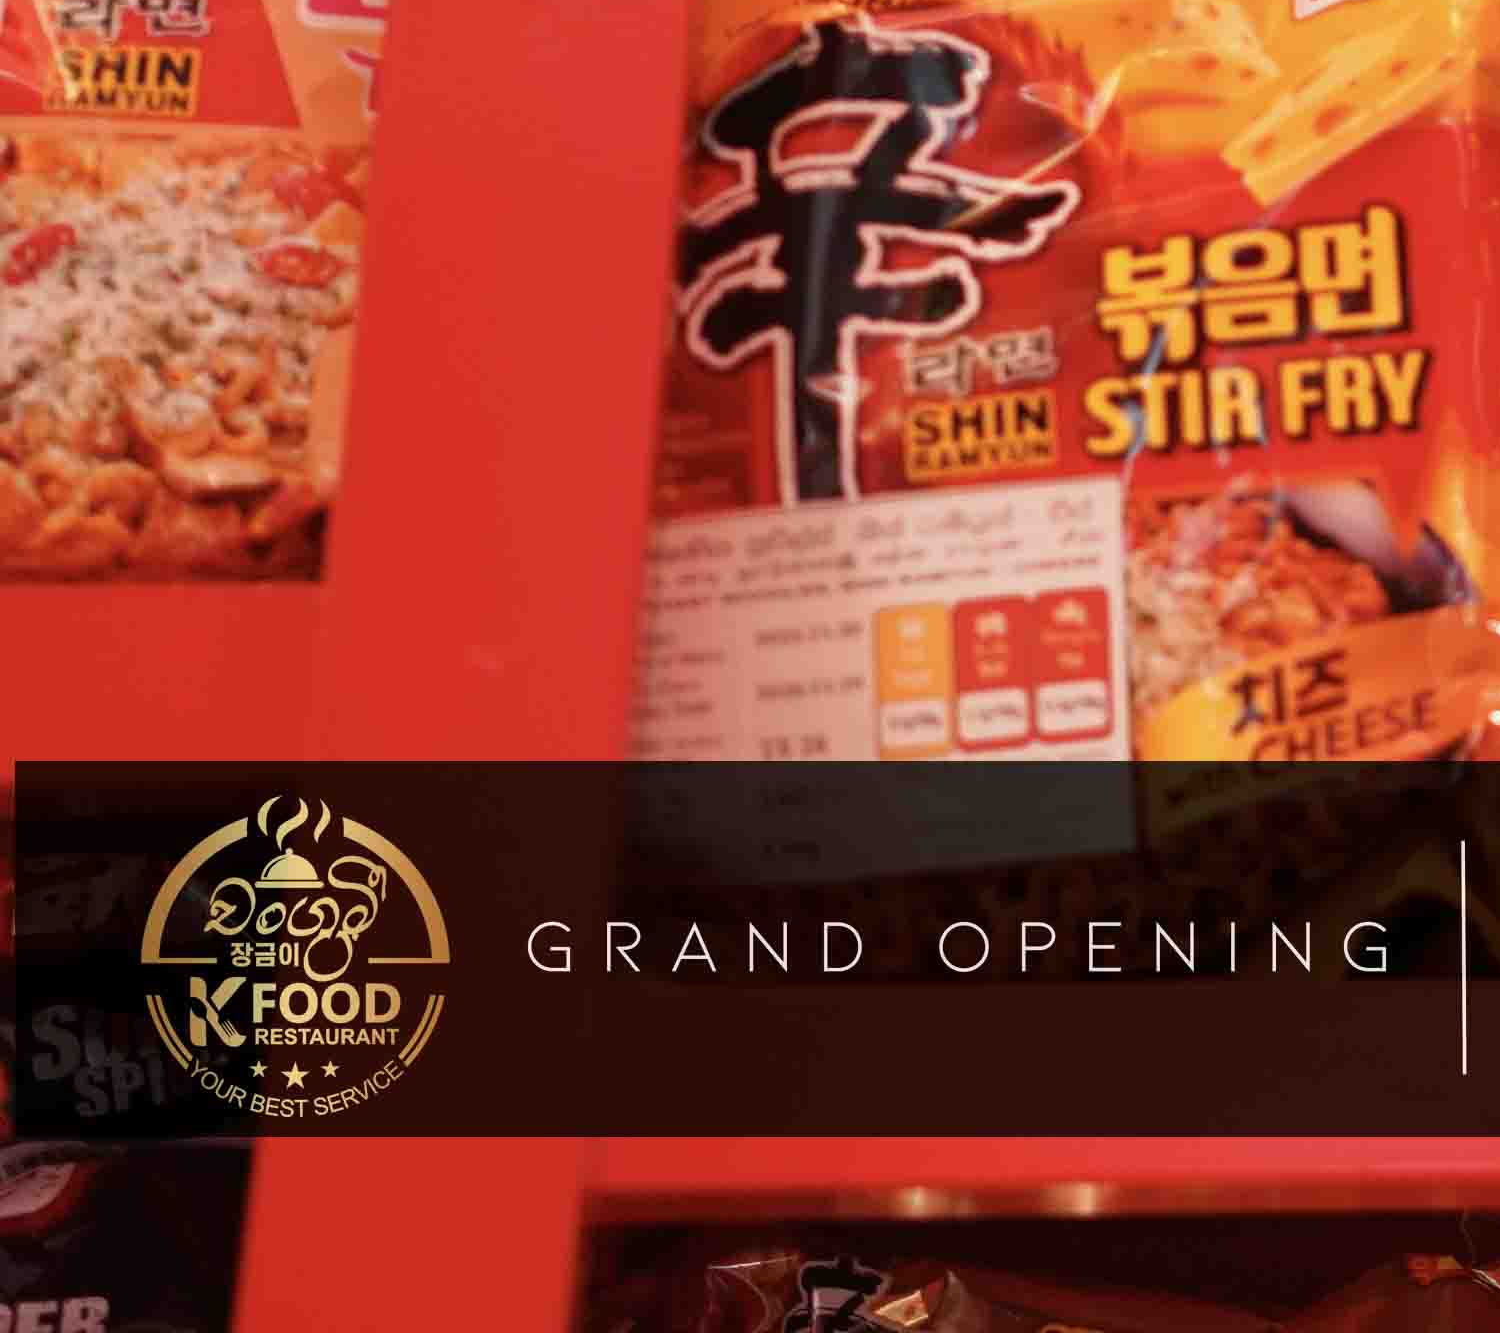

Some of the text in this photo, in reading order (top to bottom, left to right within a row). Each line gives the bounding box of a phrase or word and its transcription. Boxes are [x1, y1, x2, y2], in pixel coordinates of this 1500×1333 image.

[59, 50, 195, 89] SHIN
[1095, 204, 1411, 365] 볶음면
[908, 395, 1053, 446] SHIN
[1082, 347, 1434, 458] STIR FRY
[1227, 649, 1356, 741] 치즈
